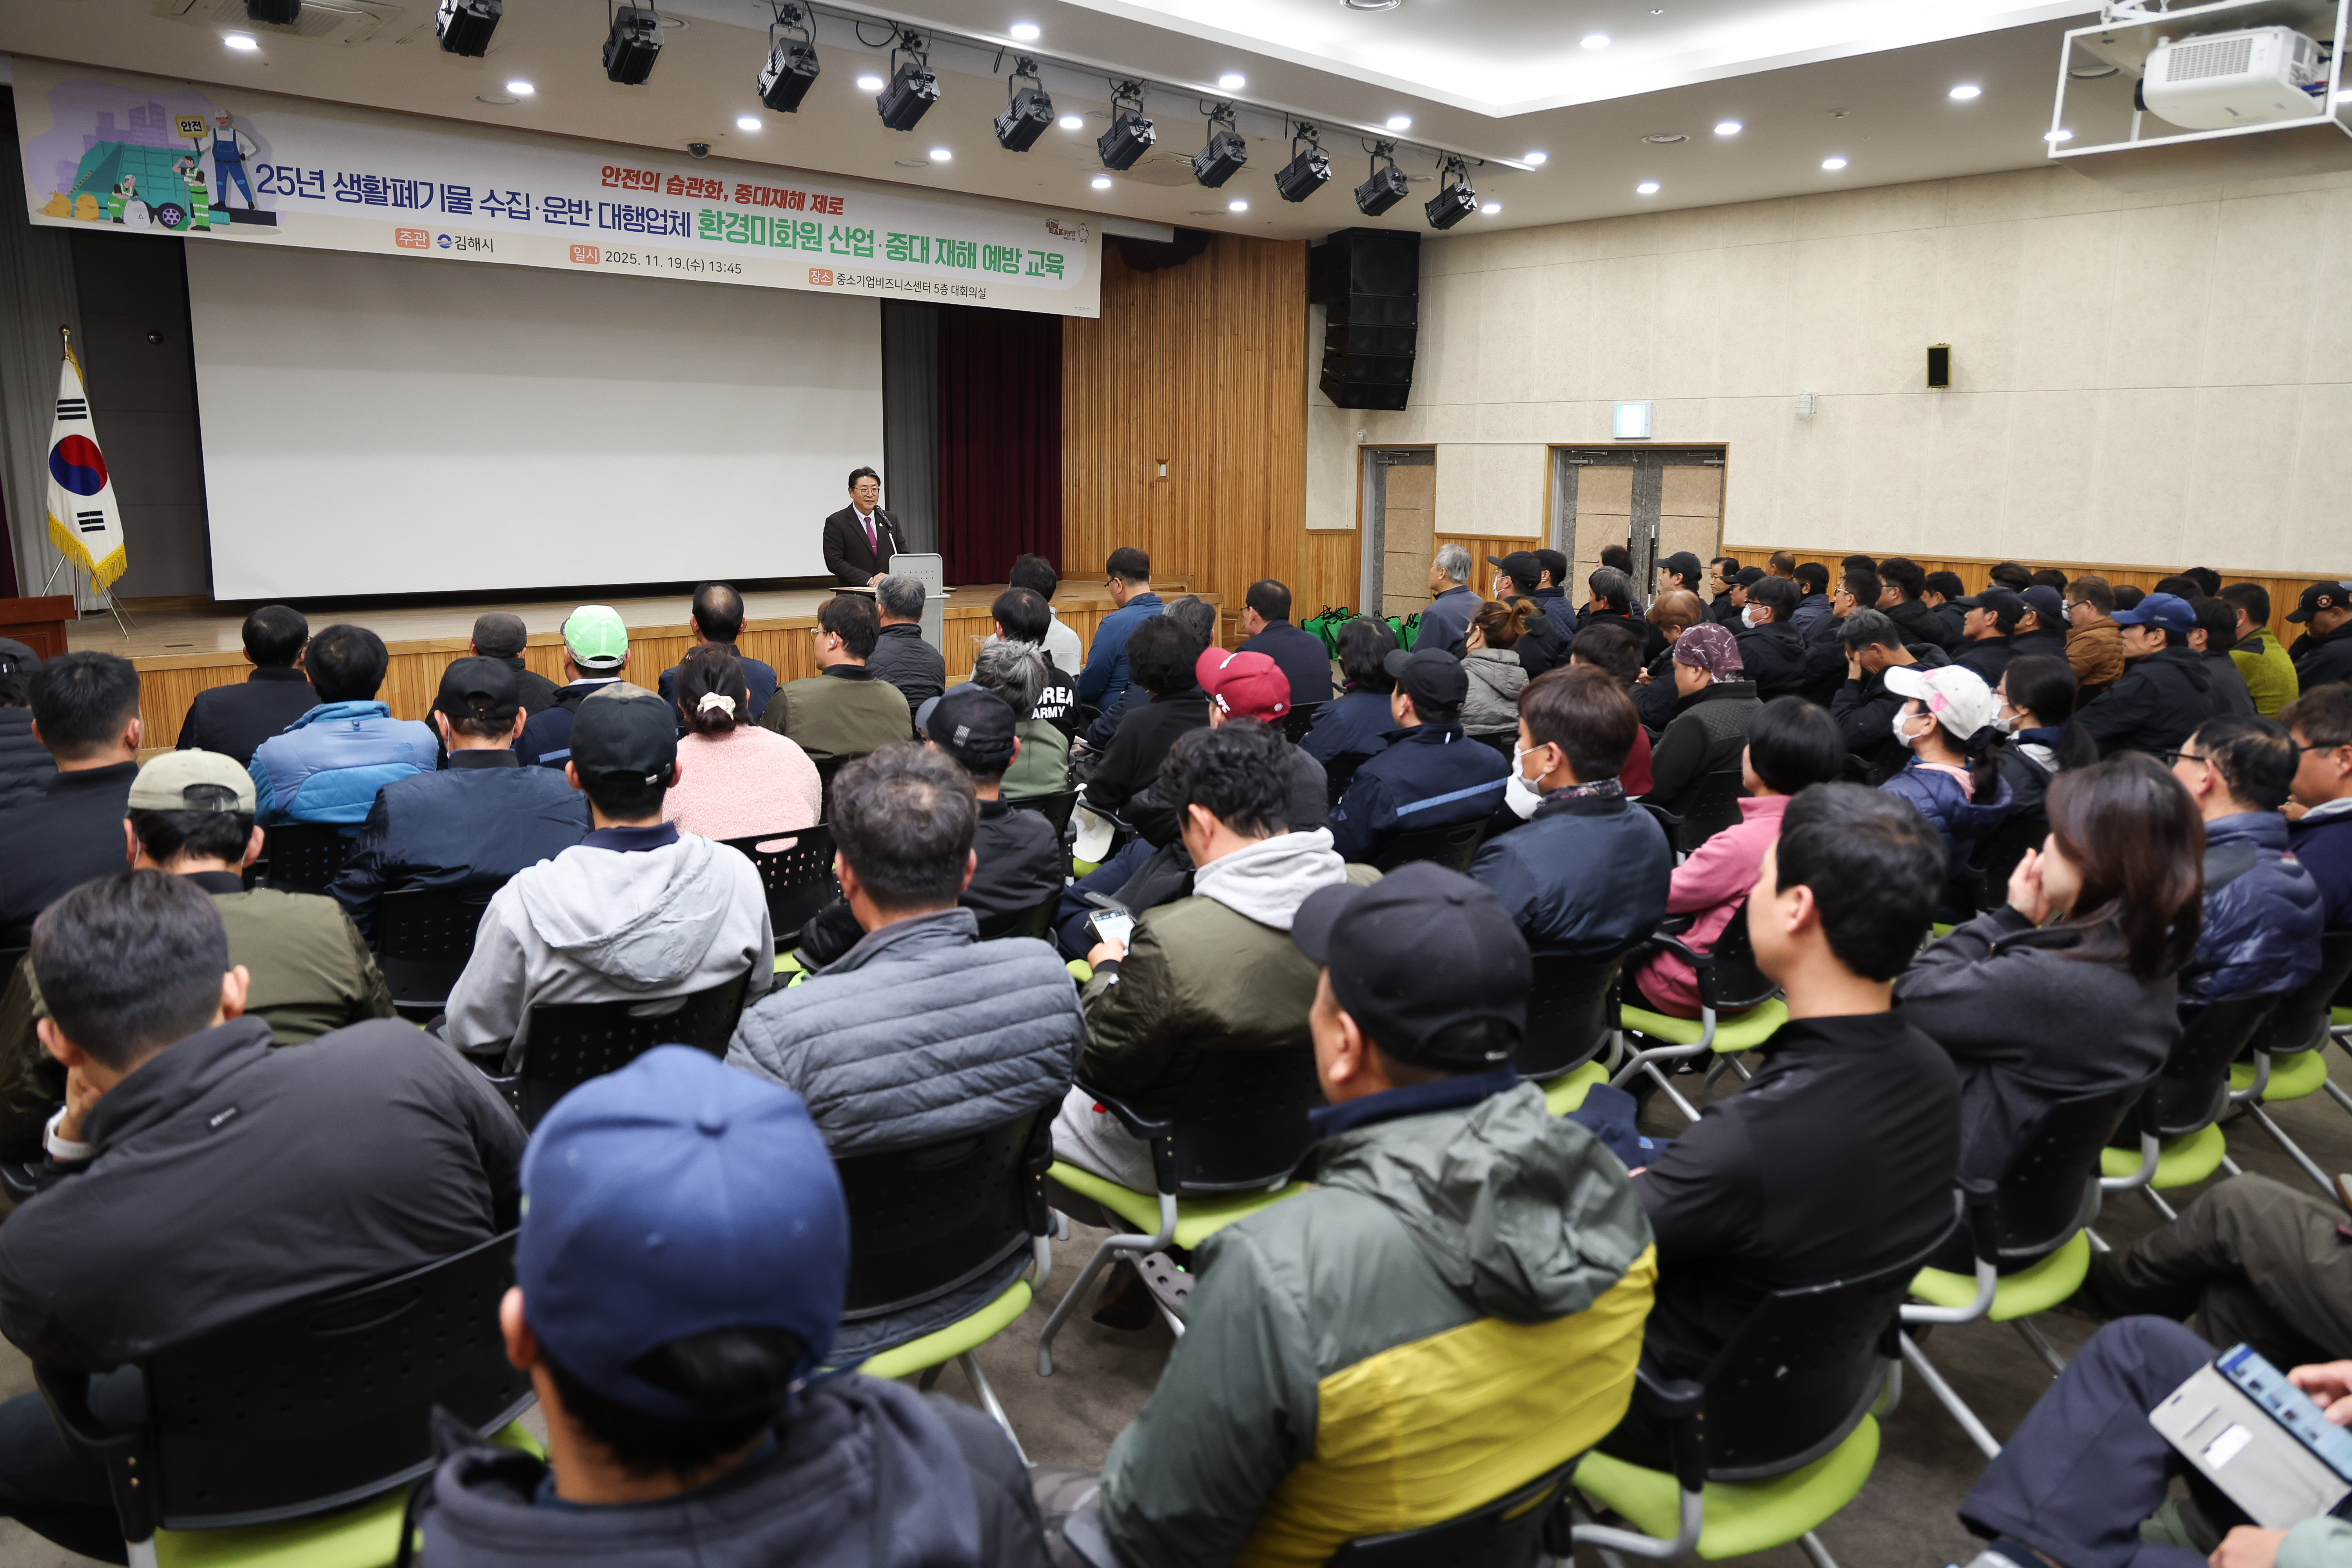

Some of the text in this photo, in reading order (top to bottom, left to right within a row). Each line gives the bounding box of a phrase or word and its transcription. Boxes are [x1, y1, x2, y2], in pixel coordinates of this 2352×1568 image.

[181, 121, 203, 132] 안전
[602, 166, 844, 215] 안전의 습관화, 중대재해 제로
[256, 164, 326, 200] 25년
[333, 172, 473, 215] 생활폐기물
[599, 203, 691, 238] 대행업체
[698, 209, 822, 252] 환경미화원
[934, 238, 977, 270] 재해
[983, 245, 1022, 274] 예방
[1025, 250, 1064, 279] 교육
[399, 231, 493, 253] 주관 김해시
[573, 247, 742, 274] 일시 2025. 11. 19.(수) 13:45
[811, 270, 986, 299] 장소 중소기업비즈니스센터 5층 대회의실
[1031, 706, 1066, 720] ARMY
[1215, 693, 1231, 713] UFC
